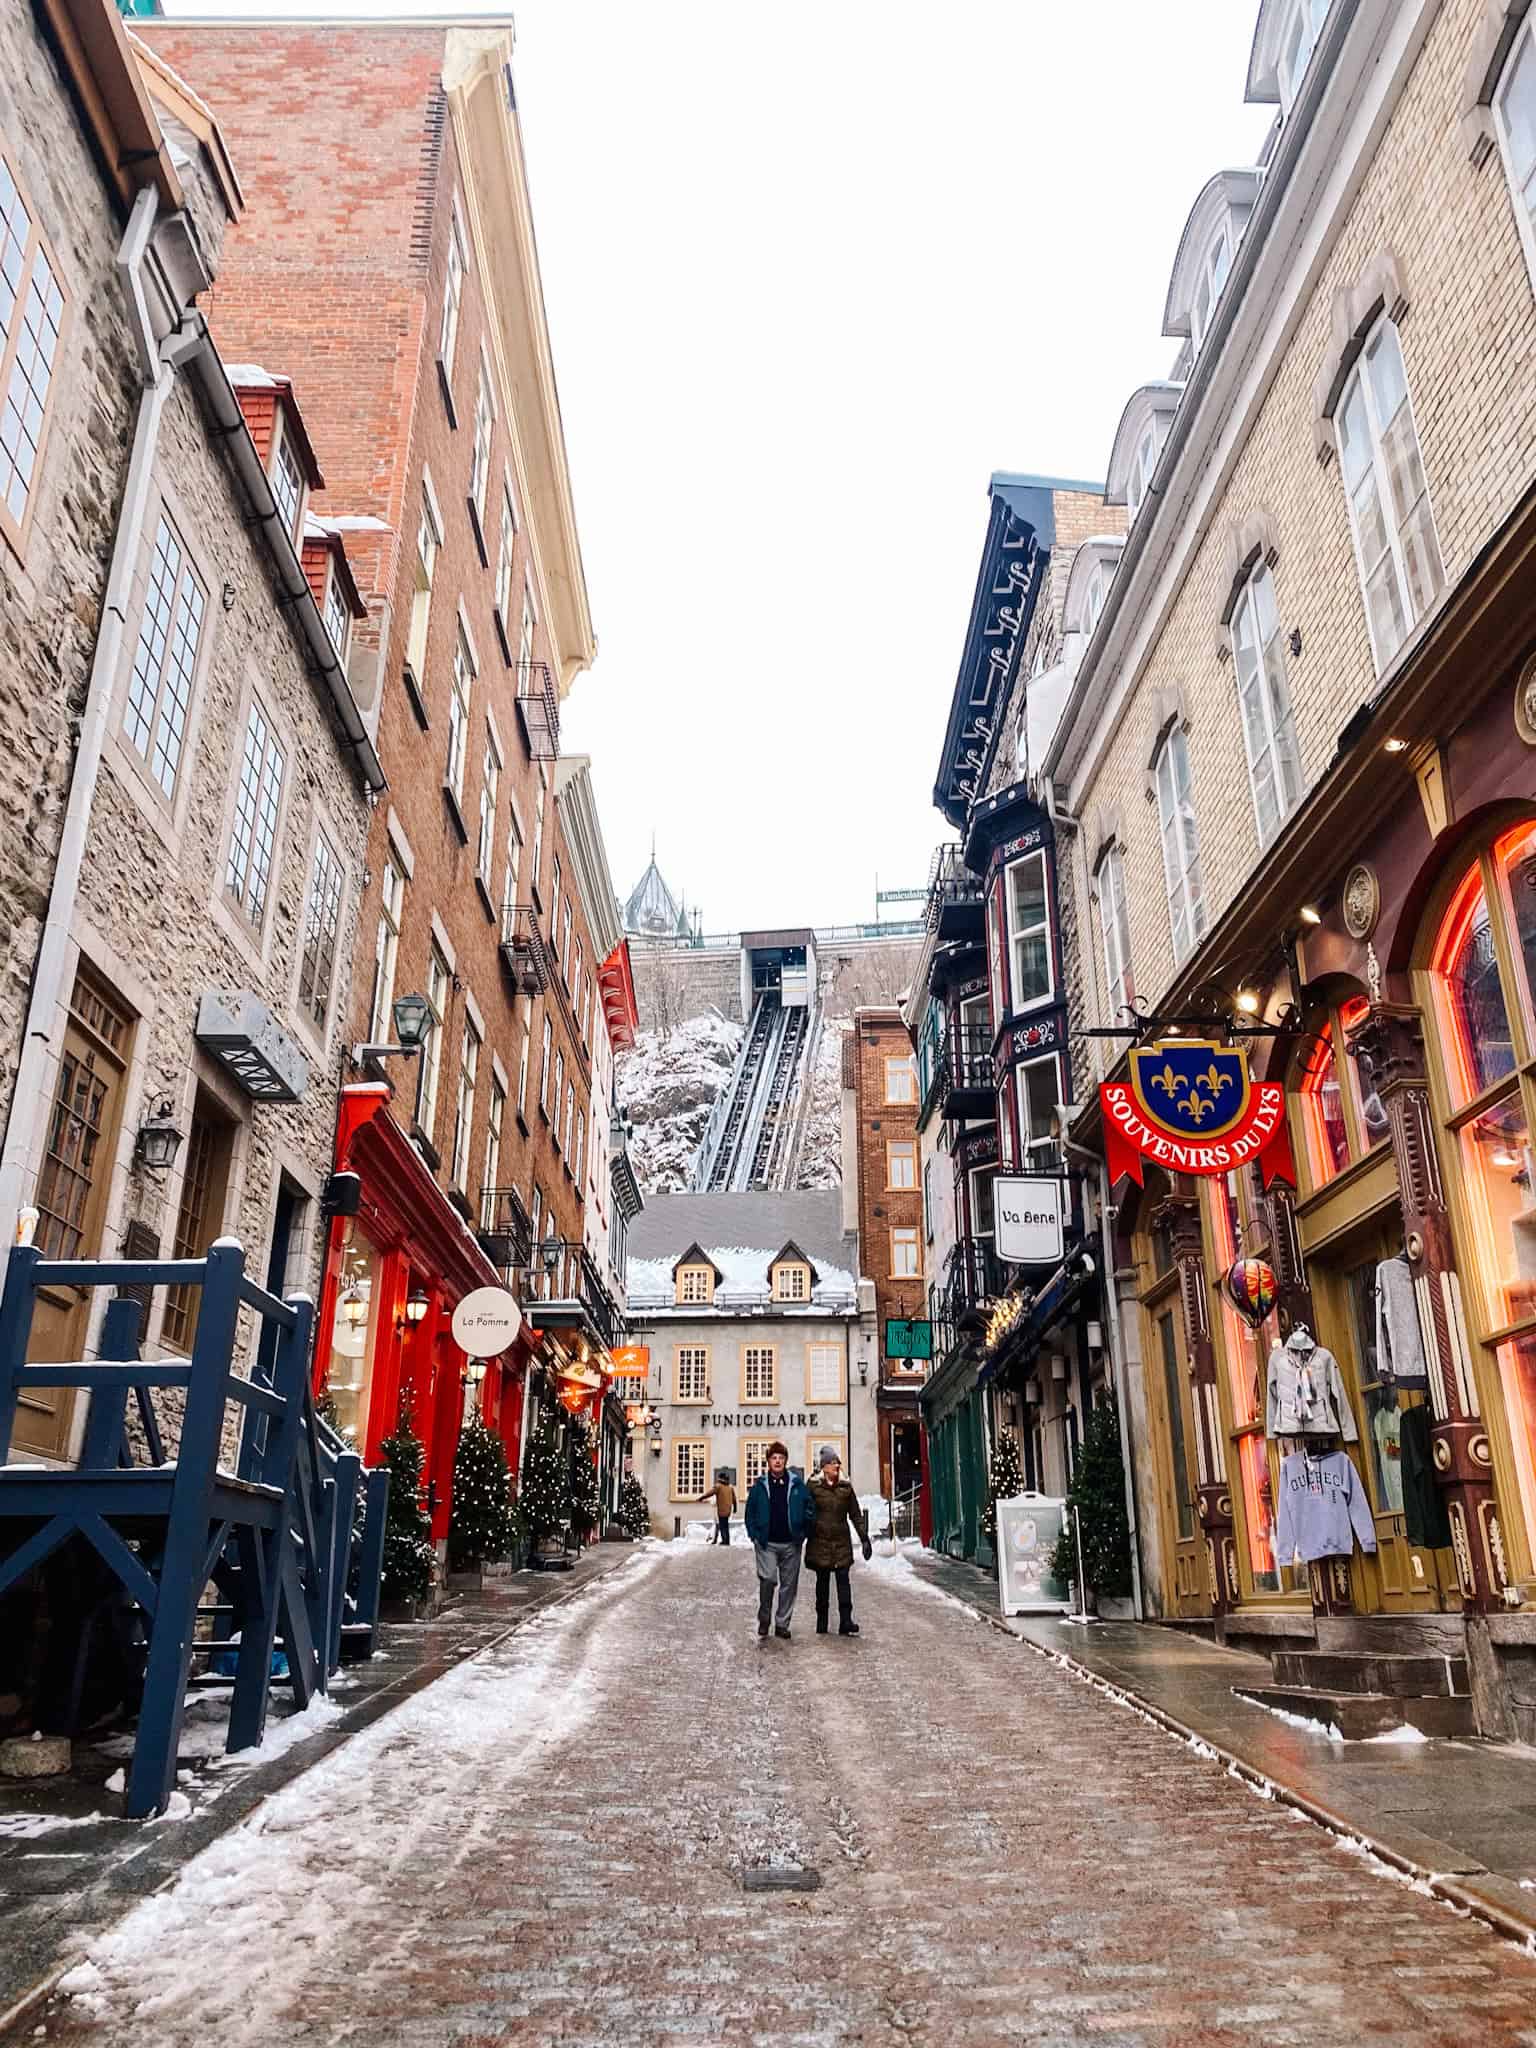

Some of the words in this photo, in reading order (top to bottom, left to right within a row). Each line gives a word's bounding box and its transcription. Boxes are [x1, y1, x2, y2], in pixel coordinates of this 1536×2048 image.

[1106, 1087, 1231, 1168] SOUVENIRS
[1231, 1130, 1261, 1159] DU
[1260, 1087, 1281, 1136] LYS
[1023, 1211, 1056, 1224] Bene
[476, 1317, 509, 1328] Pomme
[700, 1413, 818, 1428] FUNICULAIRE
